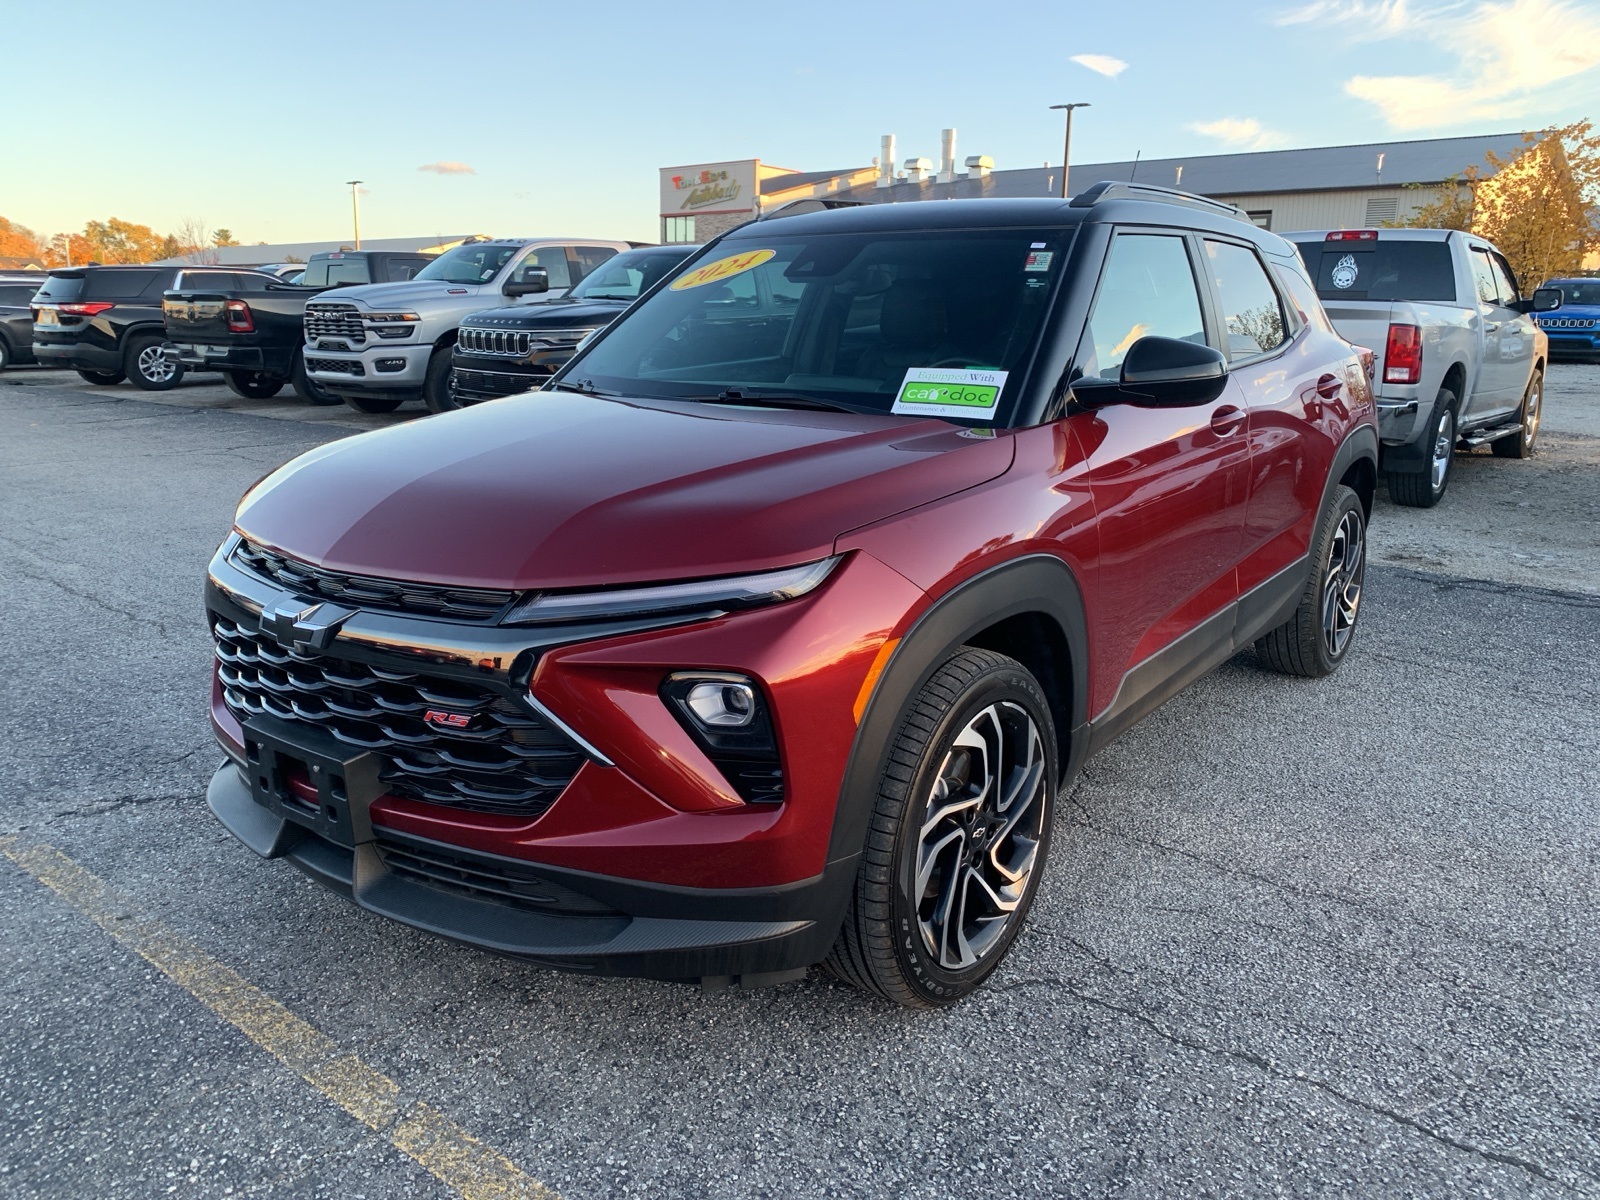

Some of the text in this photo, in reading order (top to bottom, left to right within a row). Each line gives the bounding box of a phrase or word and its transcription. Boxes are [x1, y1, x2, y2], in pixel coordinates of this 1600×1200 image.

[683, 252, 761, 288] 2024
[917, 371, 995, 382] Equipped With
[949, 387, 990, 403] doc
[898, 404, 940, 412] Maintenance
[948, 406, 991, 416] Membership
[423, 710, 471, 727] RS
